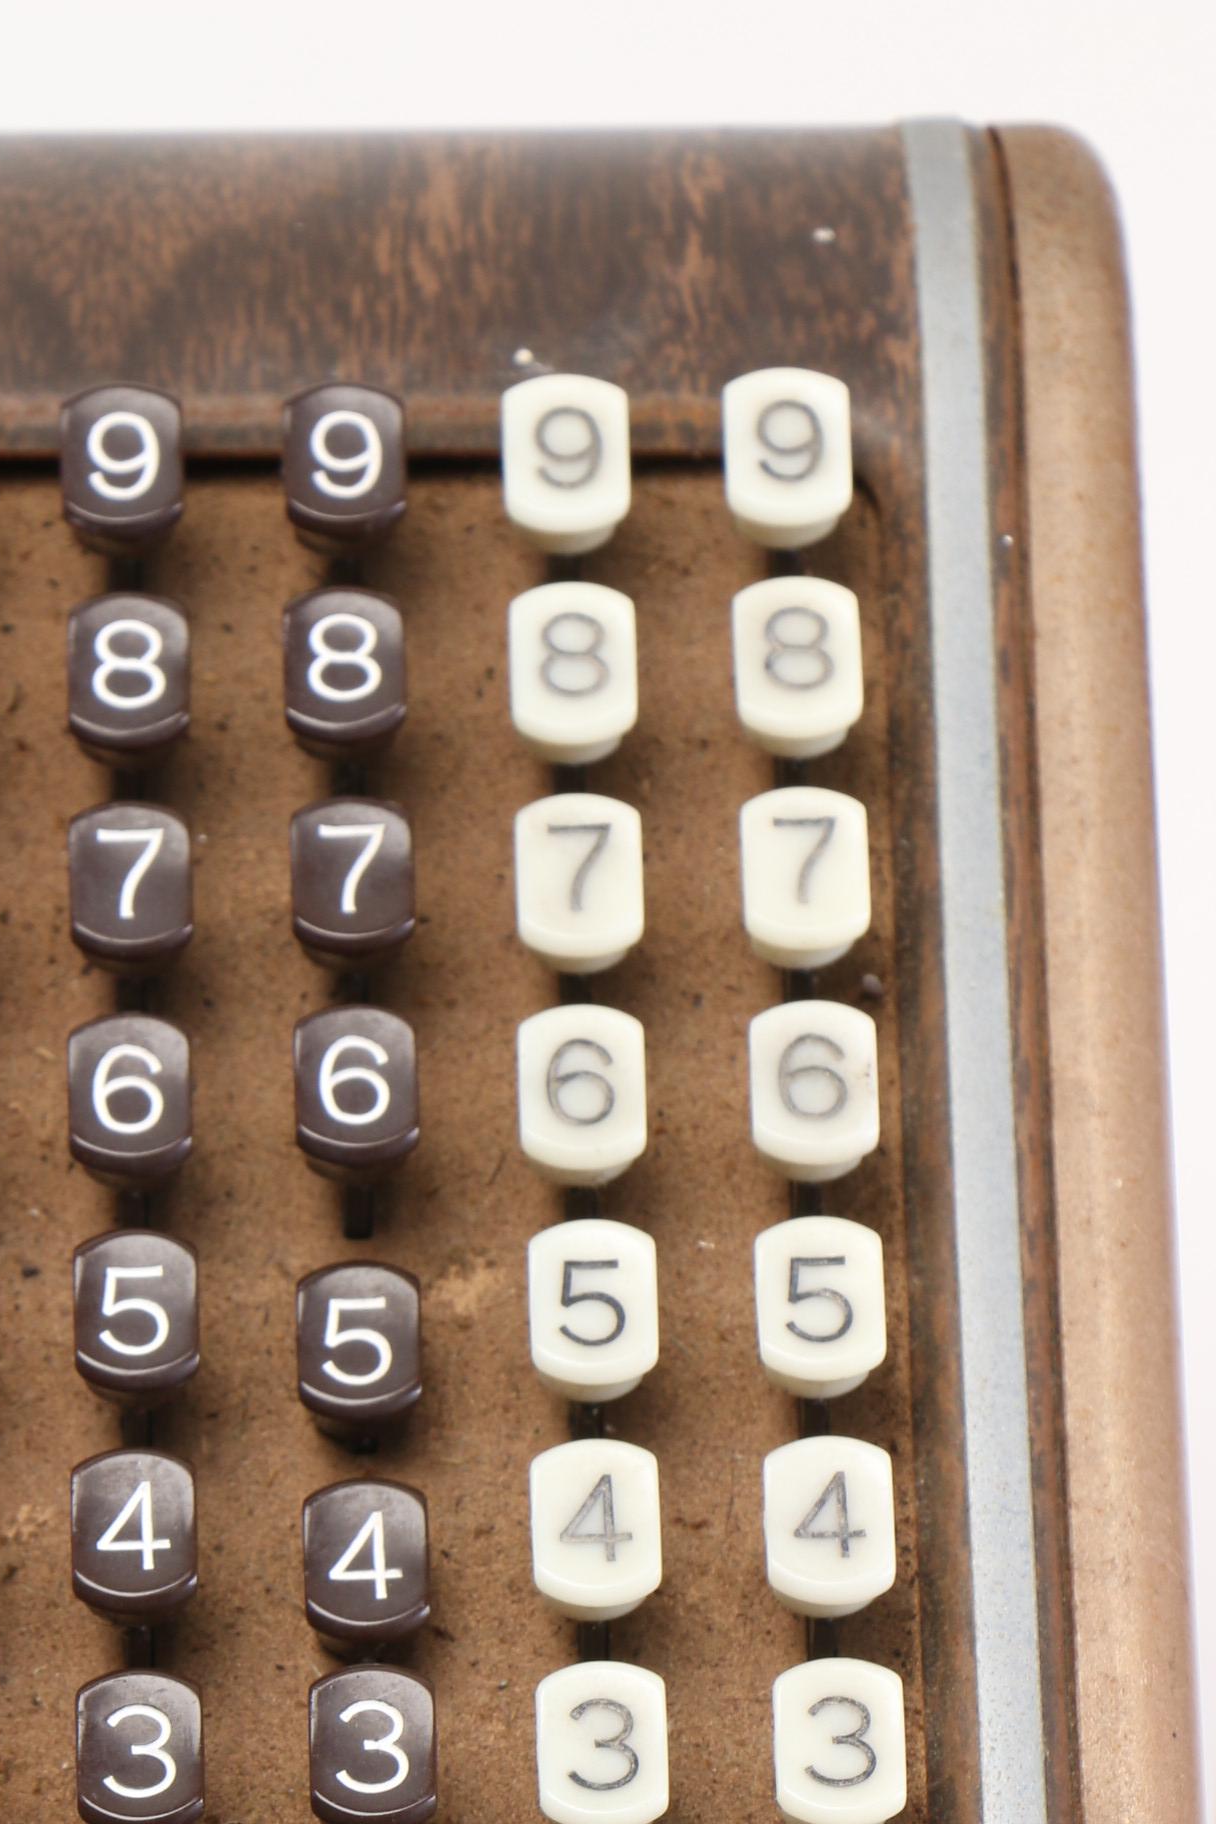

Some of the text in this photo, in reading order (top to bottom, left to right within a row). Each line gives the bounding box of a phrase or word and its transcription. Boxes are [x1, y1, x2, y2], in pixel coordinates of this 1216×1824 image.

[87, 412, 160, 501] 9
[310, 411, 382, 499] 9
[533, 405, 604, 490] 9
[754, 399, 824, 484] 9
[92, 620, 166, 710] 8
[307, 614, 382, 702] 8
[538, 612, 610, 700] 8
[762, 606, 835, 693] 8
[97, 828, 164, 919] 7
[318, 824, 384, 914] 7
[546, 822, 612, 913] 7
[771, 816, 837, 905] 7
[92, 1044, 164, 1135] 6
[319, 1035, 390, 1126] 6
[545, 1038, 616, 1128] 6
[777, 1033, 850, 1122] 6
[99, 1266, 169, 1356] 5
[322, 1297, 392, 1386] 5
[559, 1259, 626, 1348] 5
[785, 1255, 854, 1344] 5
[96, 1481, 171, 1571] 4
[328, 1511, 403, 1600] 4
[559, 1473, 633, 1563] 4
[793, 1471, 867, 1559] 4
[103, 1705, 176, 1799] 3
[336, 1700, 409, 1794] 3
[567, 1698, 640, 1793] 3
[804, 1695, 877, 1789] 3
